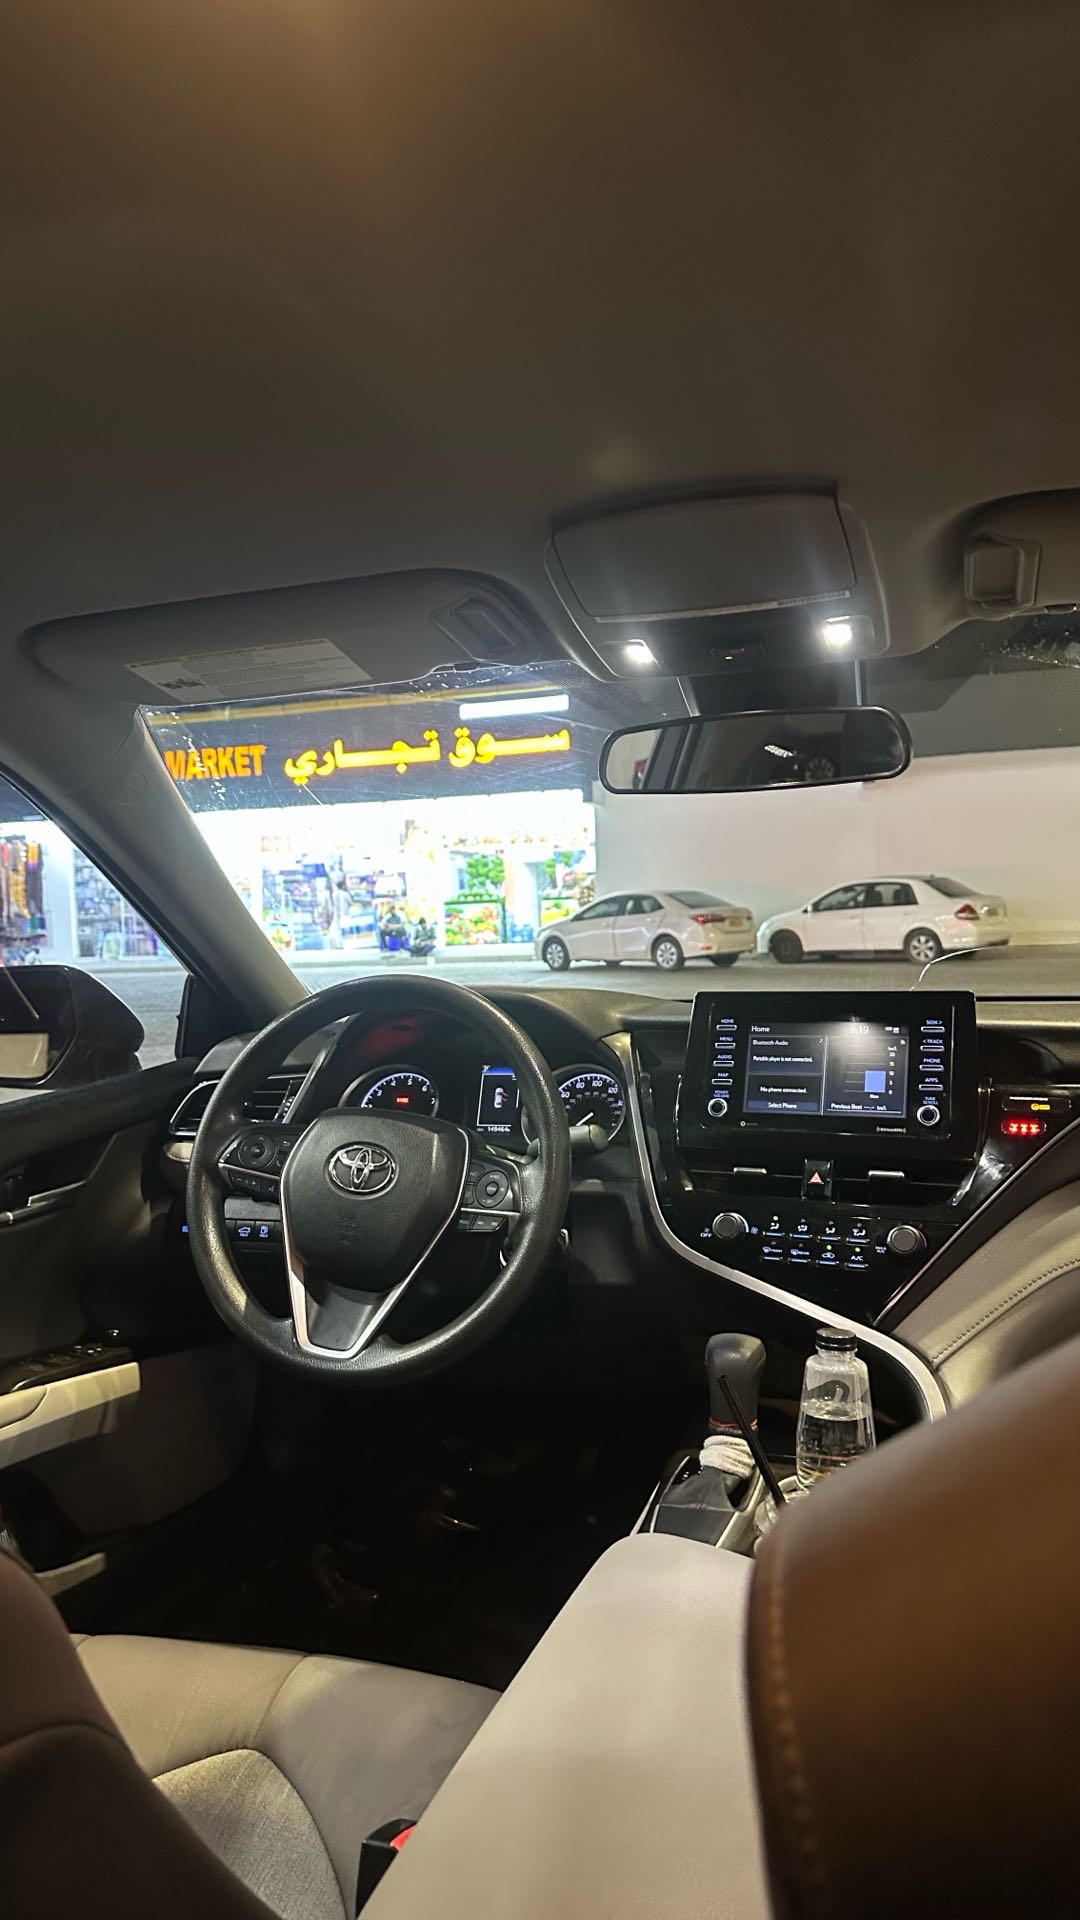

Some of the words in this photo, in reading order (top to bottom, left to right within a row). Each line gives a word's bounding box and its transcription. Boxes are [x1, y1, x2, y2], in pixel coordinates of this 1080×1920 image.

[164, 744, 266, 780] MARKET
[284, 729, 441, 785] تجاري
[448, 727, 571, 767] سوق
